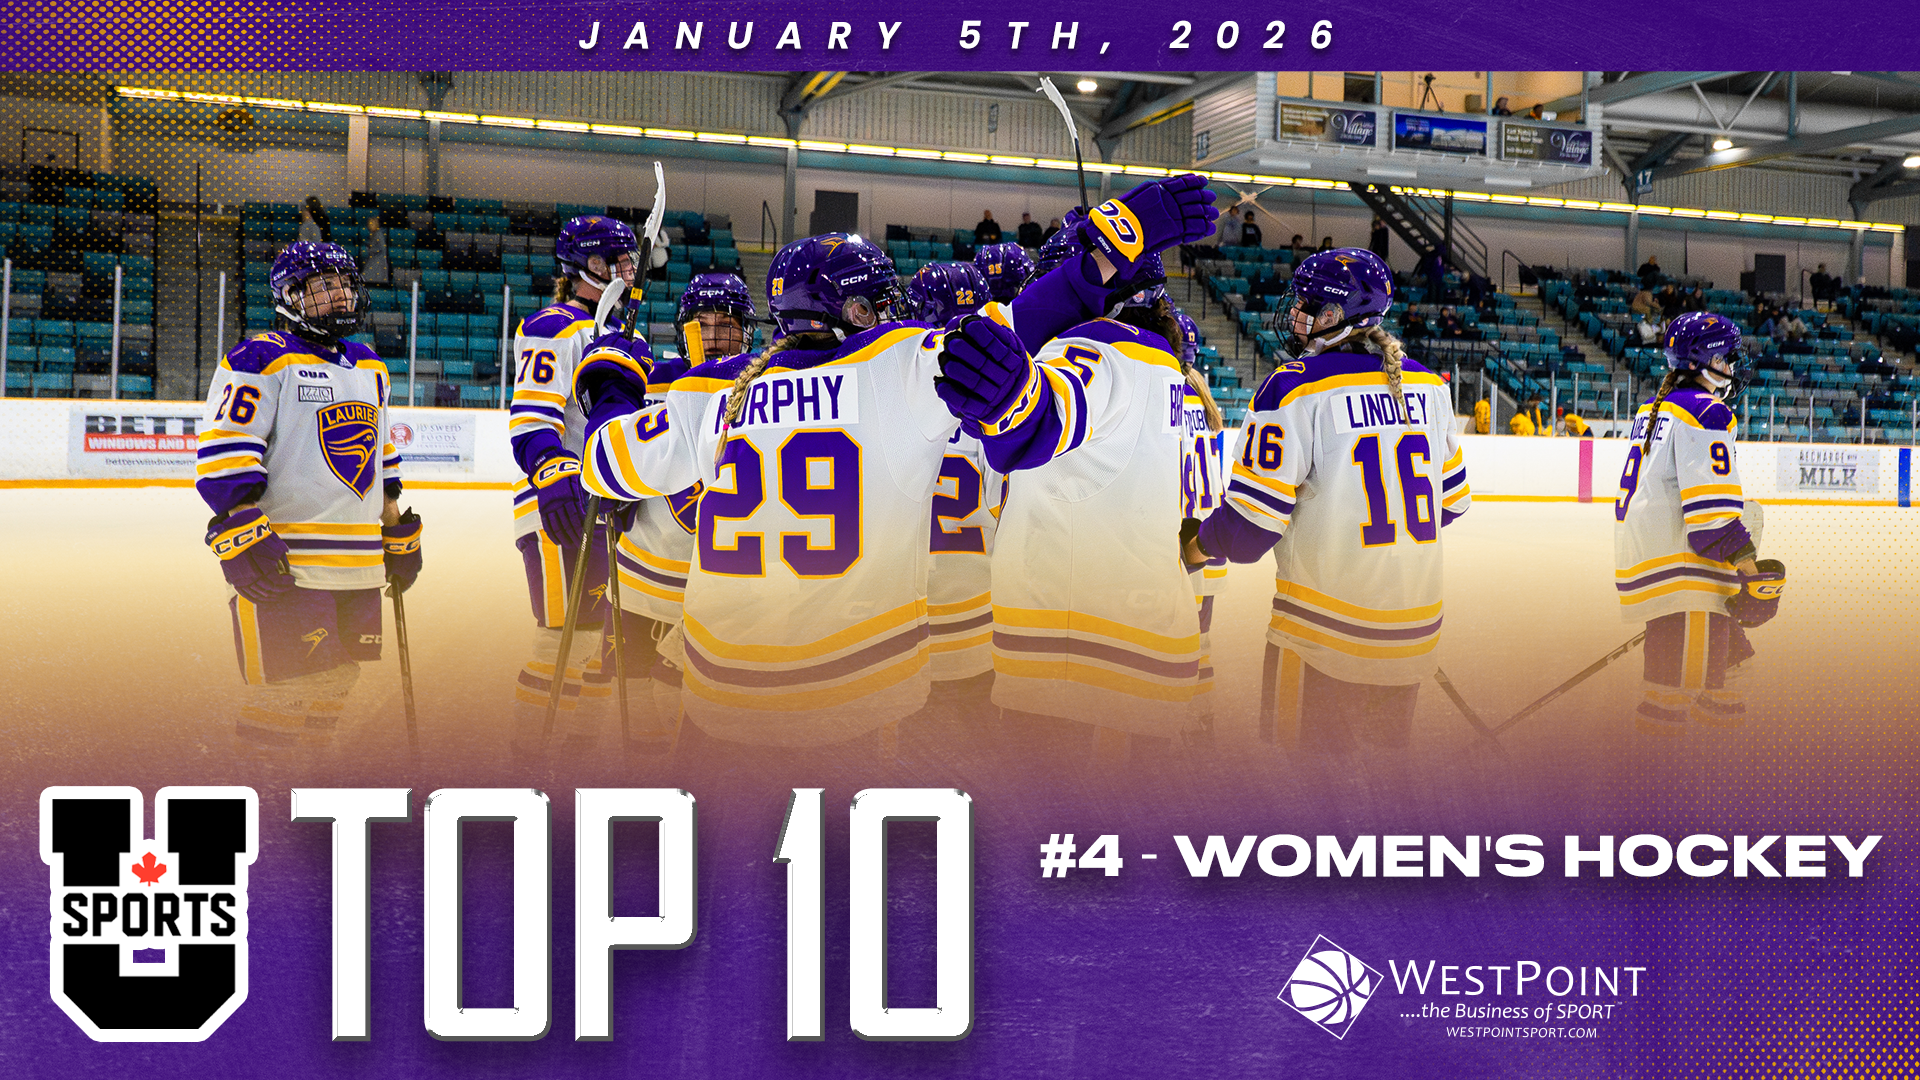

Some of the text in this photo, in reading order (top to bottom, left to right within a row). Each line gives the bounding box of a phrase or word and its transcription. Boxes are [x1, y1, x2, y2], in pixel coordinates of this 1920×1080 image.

[770, 277, 785, 297] 29
[840, 273, 868, 287] CCM
[1323, 285, 1350, 297] CCM
[698, 288, 726, 299] CCM
[955, 290, 975, 306] 22
[516, 349, 557, 386] 76
[214, 382, 262, 426] 26
[1346, 392, 1427, 429] LINDLEY
[88, 437, 156, 450] WINDOWS
[157, 438, 185, 450] AND
[1242, 422, 1285, 471] 16
[538, 459, 582, 482] CC
[1709, 441, 1732, 477] 9
[1799, 467, 1856, 486] MILK
[1352, 431, 1437, 549] 16
[696, 426, 864, 580] 29
[214, 519, 273, 555] CCM
[384, 538, 420, 552] CC
